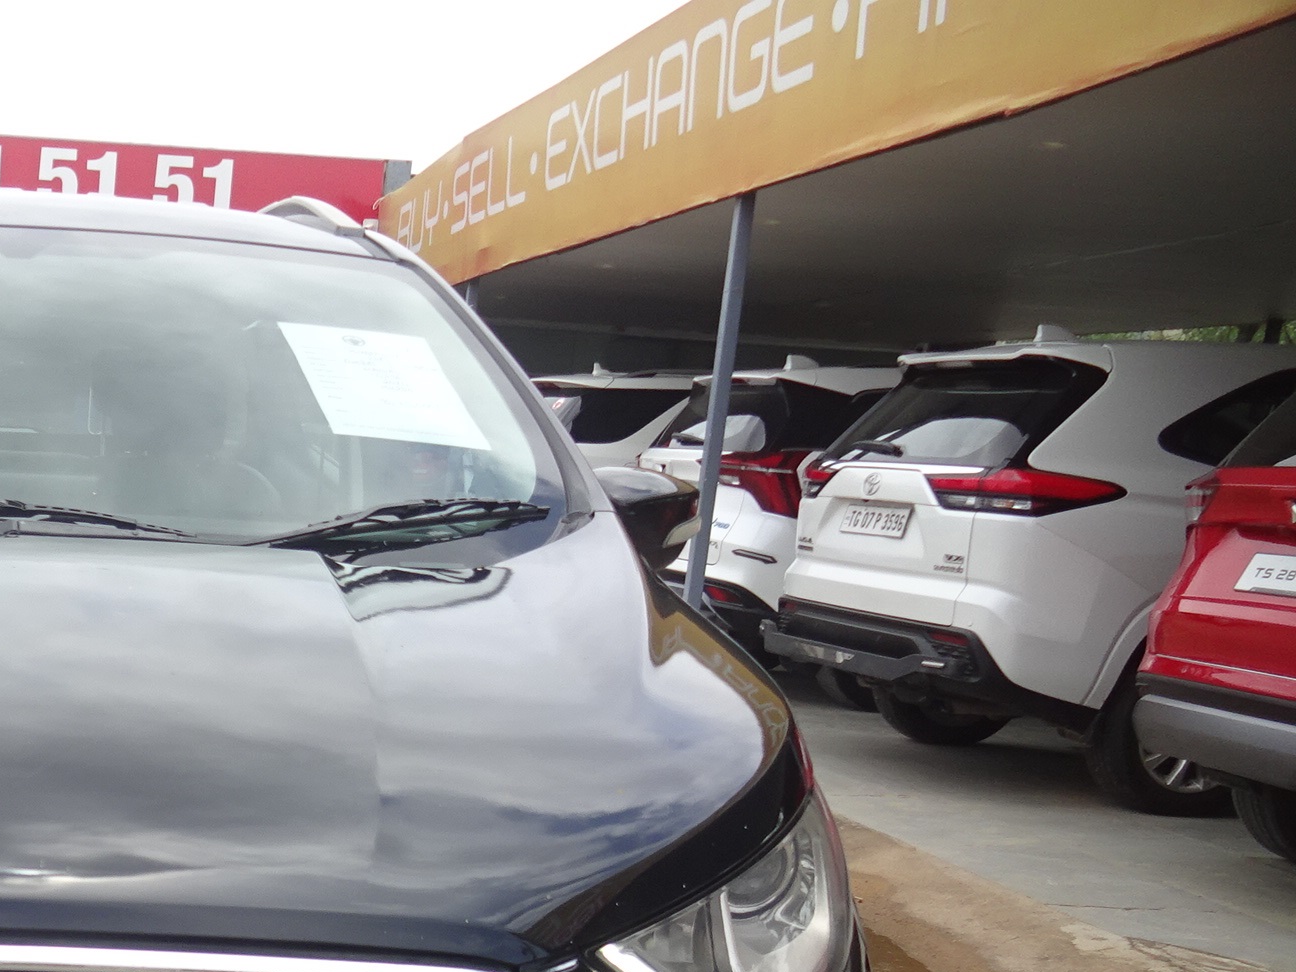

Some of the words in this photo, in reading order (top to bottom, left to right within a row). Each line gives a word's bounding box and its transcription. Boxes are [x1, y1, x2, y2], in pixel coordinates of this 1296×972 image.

[397, 180, 443, 255] BUY
[450, 136, 526, 235] SELL
[544, 0, 814, 192] EXCHANGE
[36, 146, 118, 196] 51
[153, 154, 235, 212] 51
[847, 510, 862, 527] TG
[860, 511, 876, 529] 07
[872, 512, 883, 530] P
[1254, 567, 1275, 579] TS
